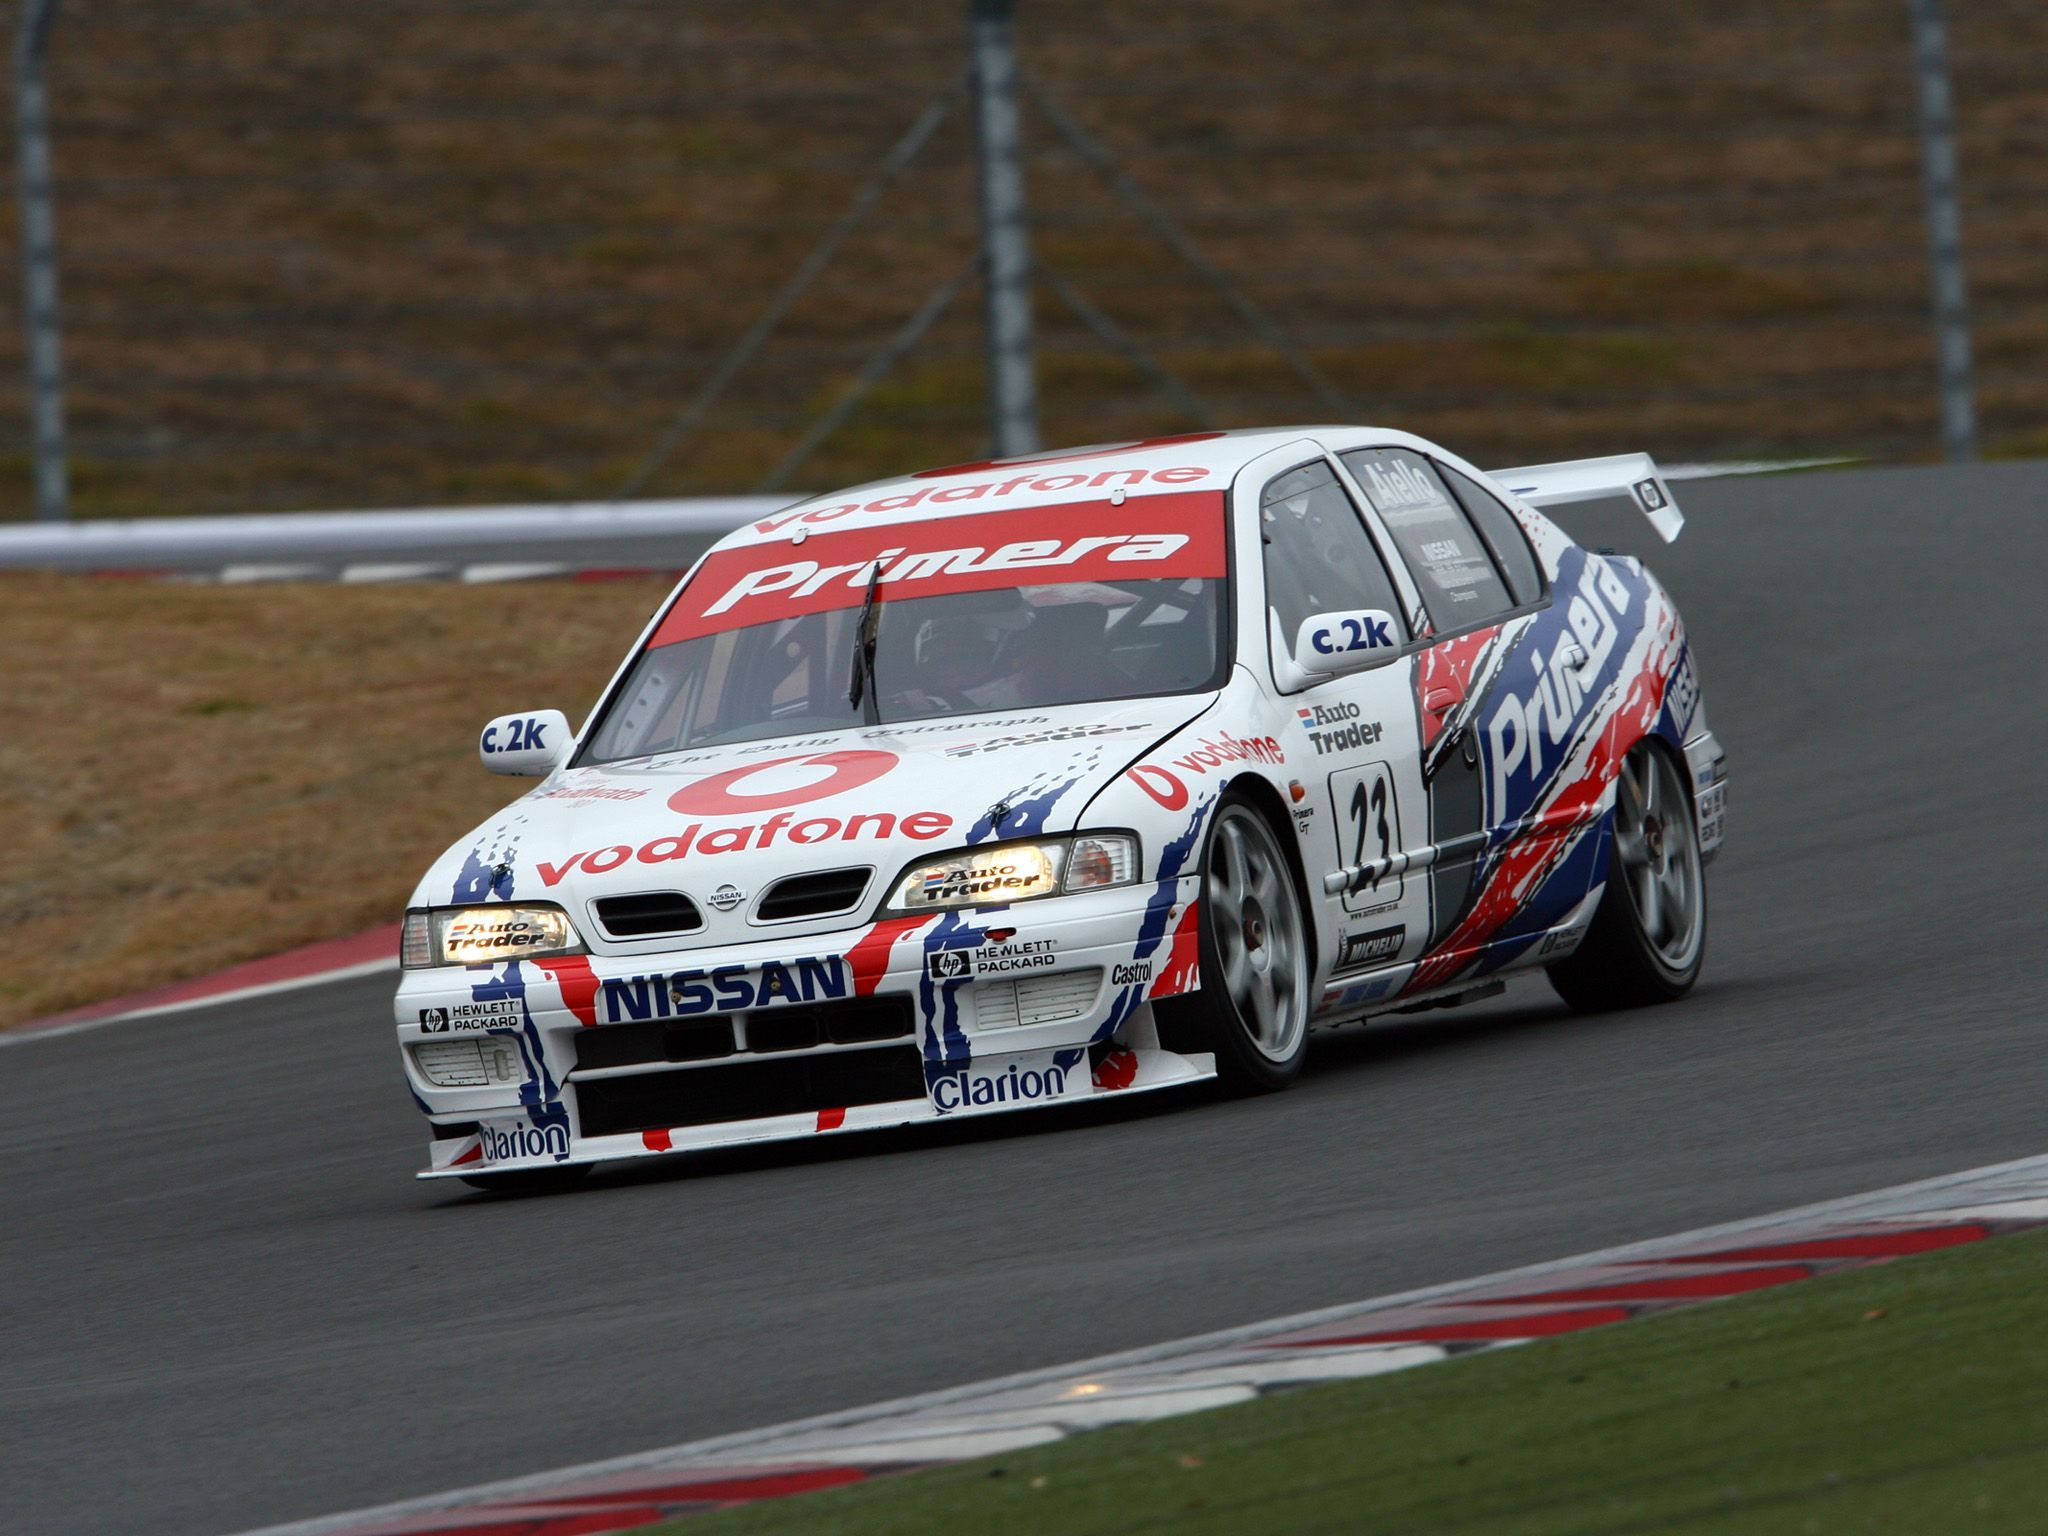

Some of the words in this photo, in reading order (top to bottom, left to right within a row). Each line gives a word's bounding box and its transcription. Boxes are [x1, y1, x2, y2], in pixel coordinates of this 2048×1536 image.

[753, 465, 1211, 536] vodafone
[701, 532, 1190, 618] Primera
[1312, 616, 1393, 655] c.2k
[1312, 701, 1361, 726] Auto
[482, 718, 547, 753] c.2k
[947, 723, 1153, 757] Trader
[980, 723, 1108, 746] Auto
[1309, 721, 1383, 755] Trader
[1172, 730, 1285, 774] vodafone
[535, 811, 954, 887] vodafone
[1350, 774, 1392, 898] 23
[948, 864, 1016, 883] Auto
[710, 892, 742, 902] NISSAN
[923, 873, 1040, 902] Trader
[467, 921, 529, 935] Auto
[448, 932, 545, 952] Trader
[975, 940, 1053, 959] HEWLETT
[1347, 933, 1405, 961] MICHELIN
[941, 953, 960, 977] hp
[977, 953, 1056, 974] PACKARD
[1112, 960, 1153, 986] Castrol
[601, 954, 847, 1023] NISSAN
[428, 1009, 442, 1033] hp
[453, 1001, 515, 1017] HEWLETT
[454, 1015, 519, 1031] PACKARD
